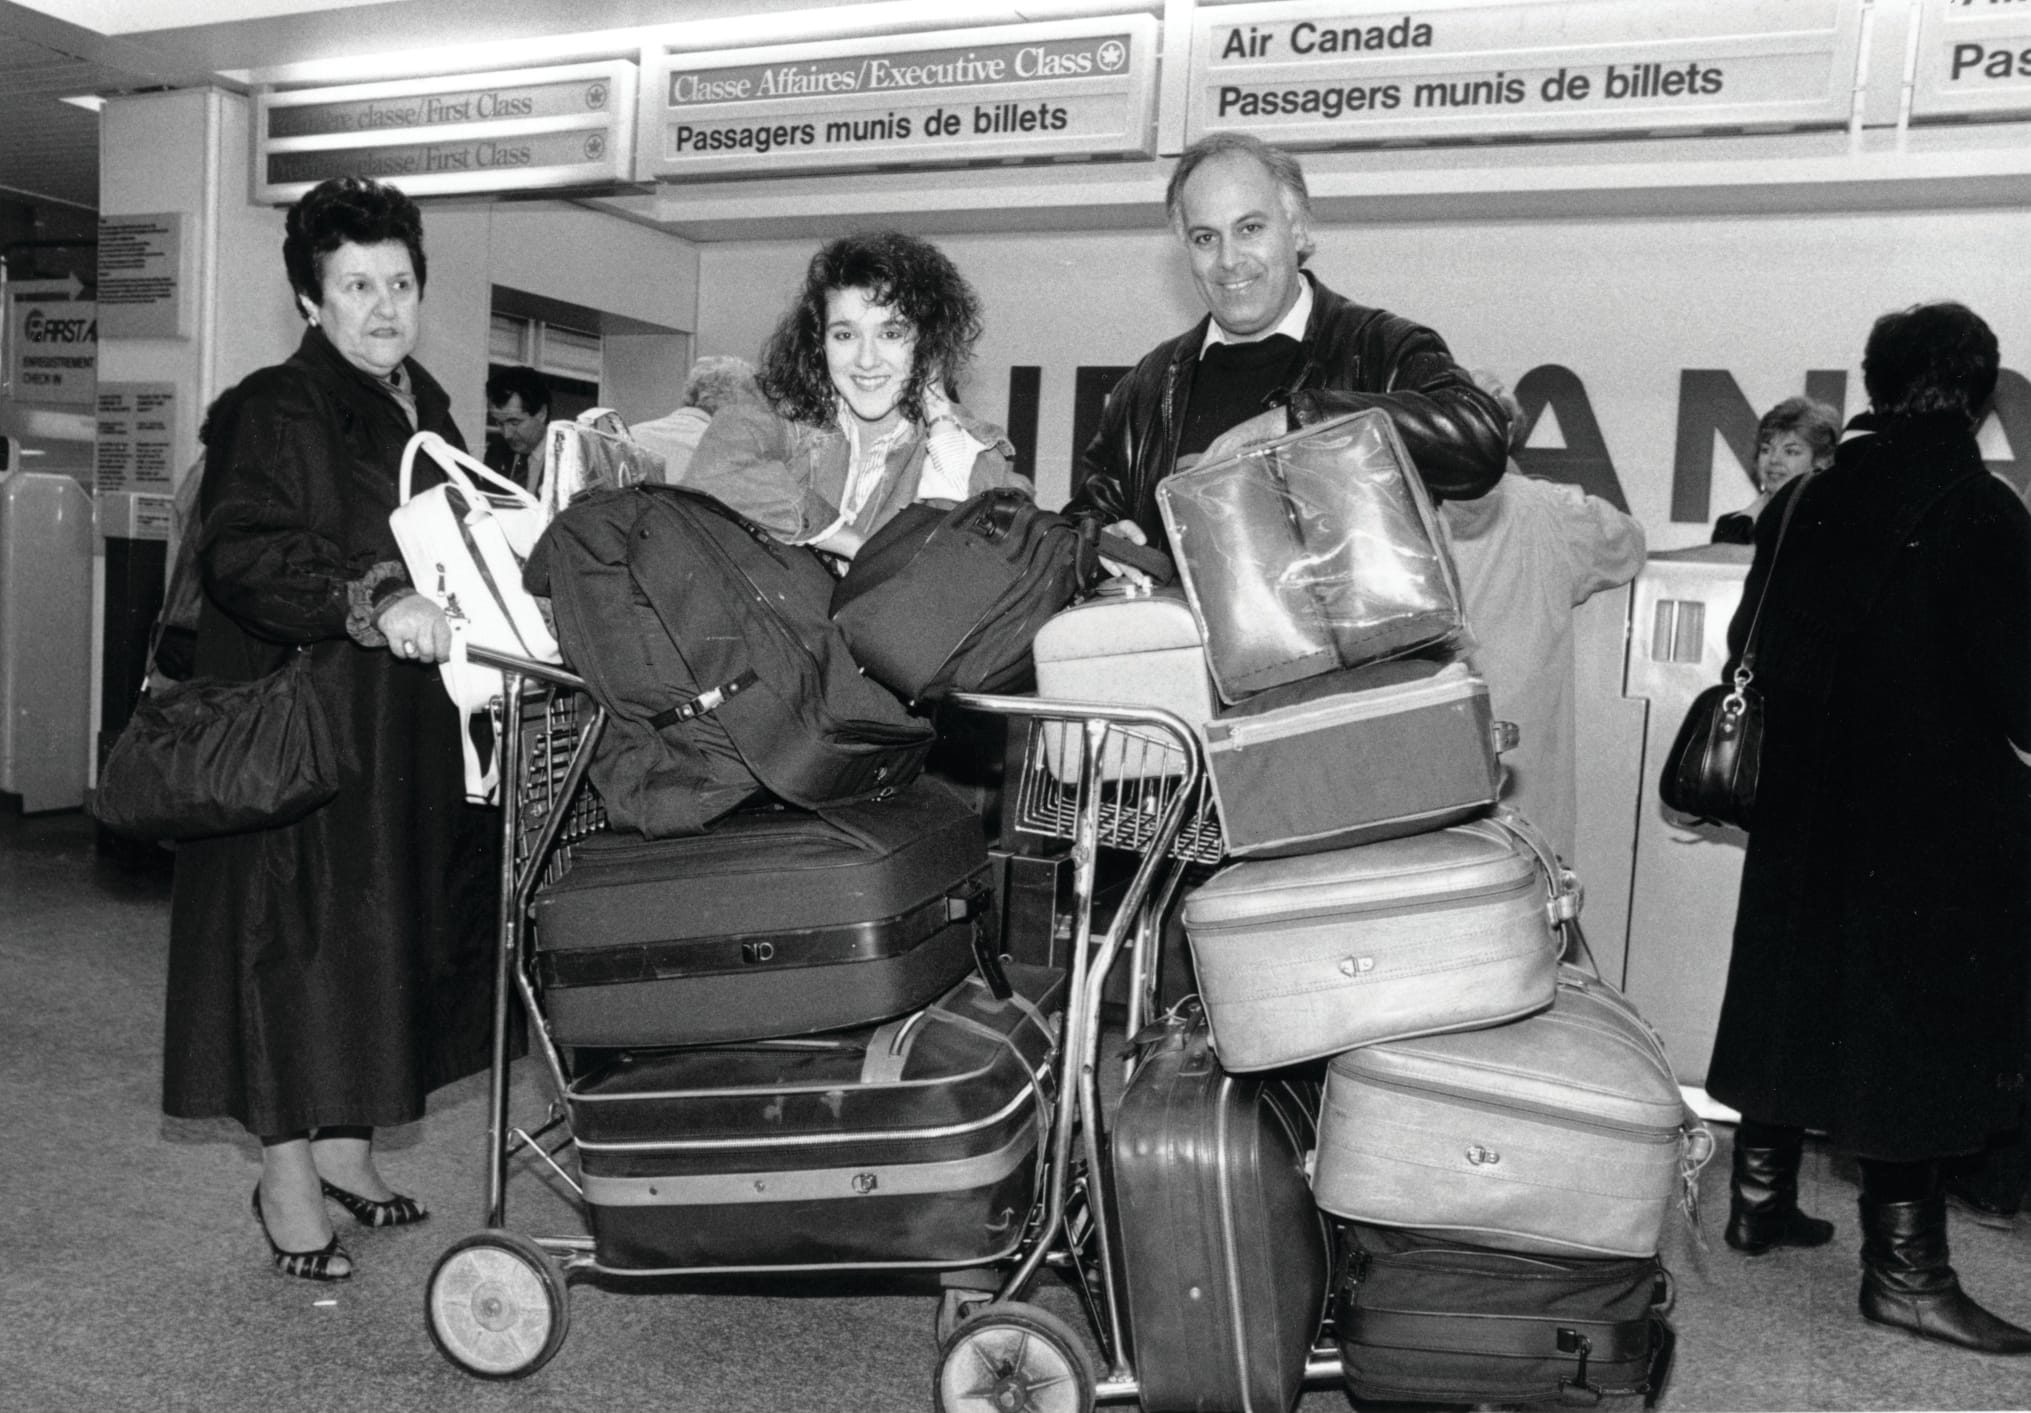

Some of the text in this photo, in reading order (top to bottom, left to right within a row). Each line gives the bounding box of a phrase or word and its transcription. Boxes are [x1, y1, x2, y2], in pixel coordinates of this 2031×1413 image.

[1221, 16, 1434, 60] Air Canada
[673, 75, 751, 103] Classe
[1014, 46, 1093, 78] Class
[1218, 62, 1725, 118] Passagers munis de billets
[476, 91, 534, 120] Class
[676, 102, 1069, 154] Passagers munis de billets
[475, 141, 532, 167] Class
